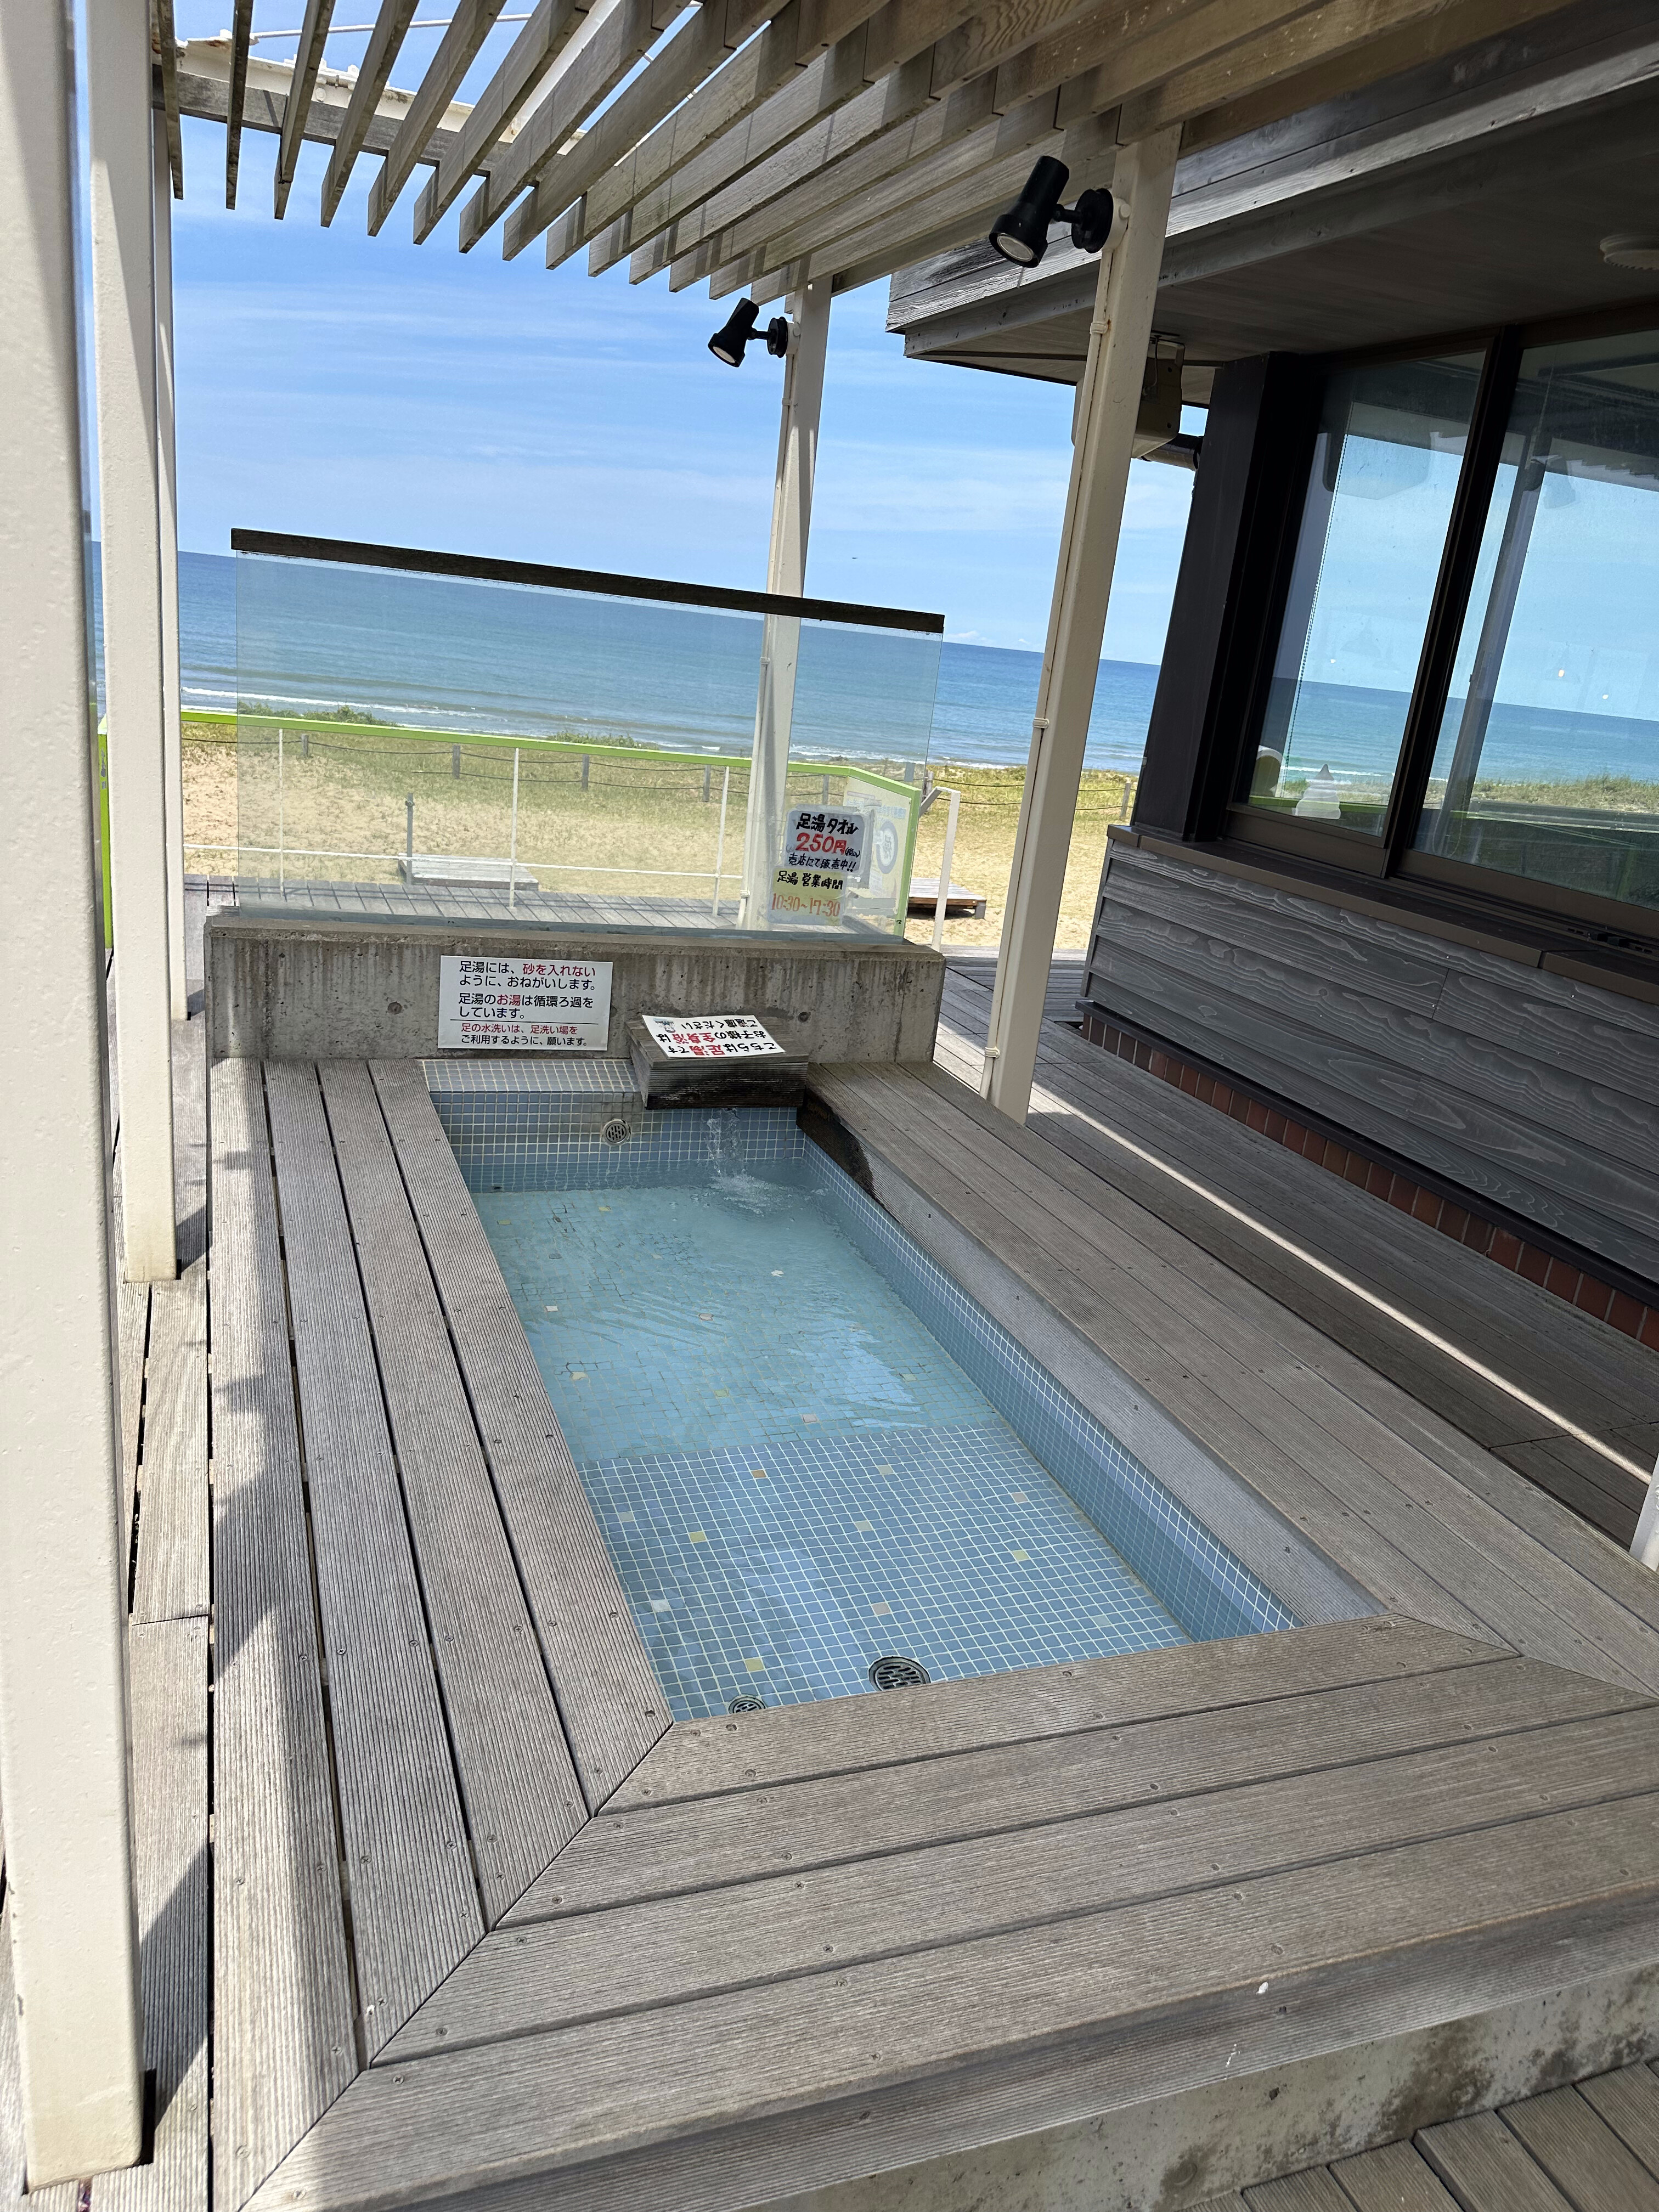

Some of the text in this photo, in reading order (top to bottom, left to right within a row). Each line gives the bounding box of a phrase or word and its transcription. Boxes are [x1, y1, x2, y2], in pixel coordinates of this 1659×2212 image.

[459, 1006, 525, 1019] しています。
[668, 1042, 777, 1056] こちらは足湯です
